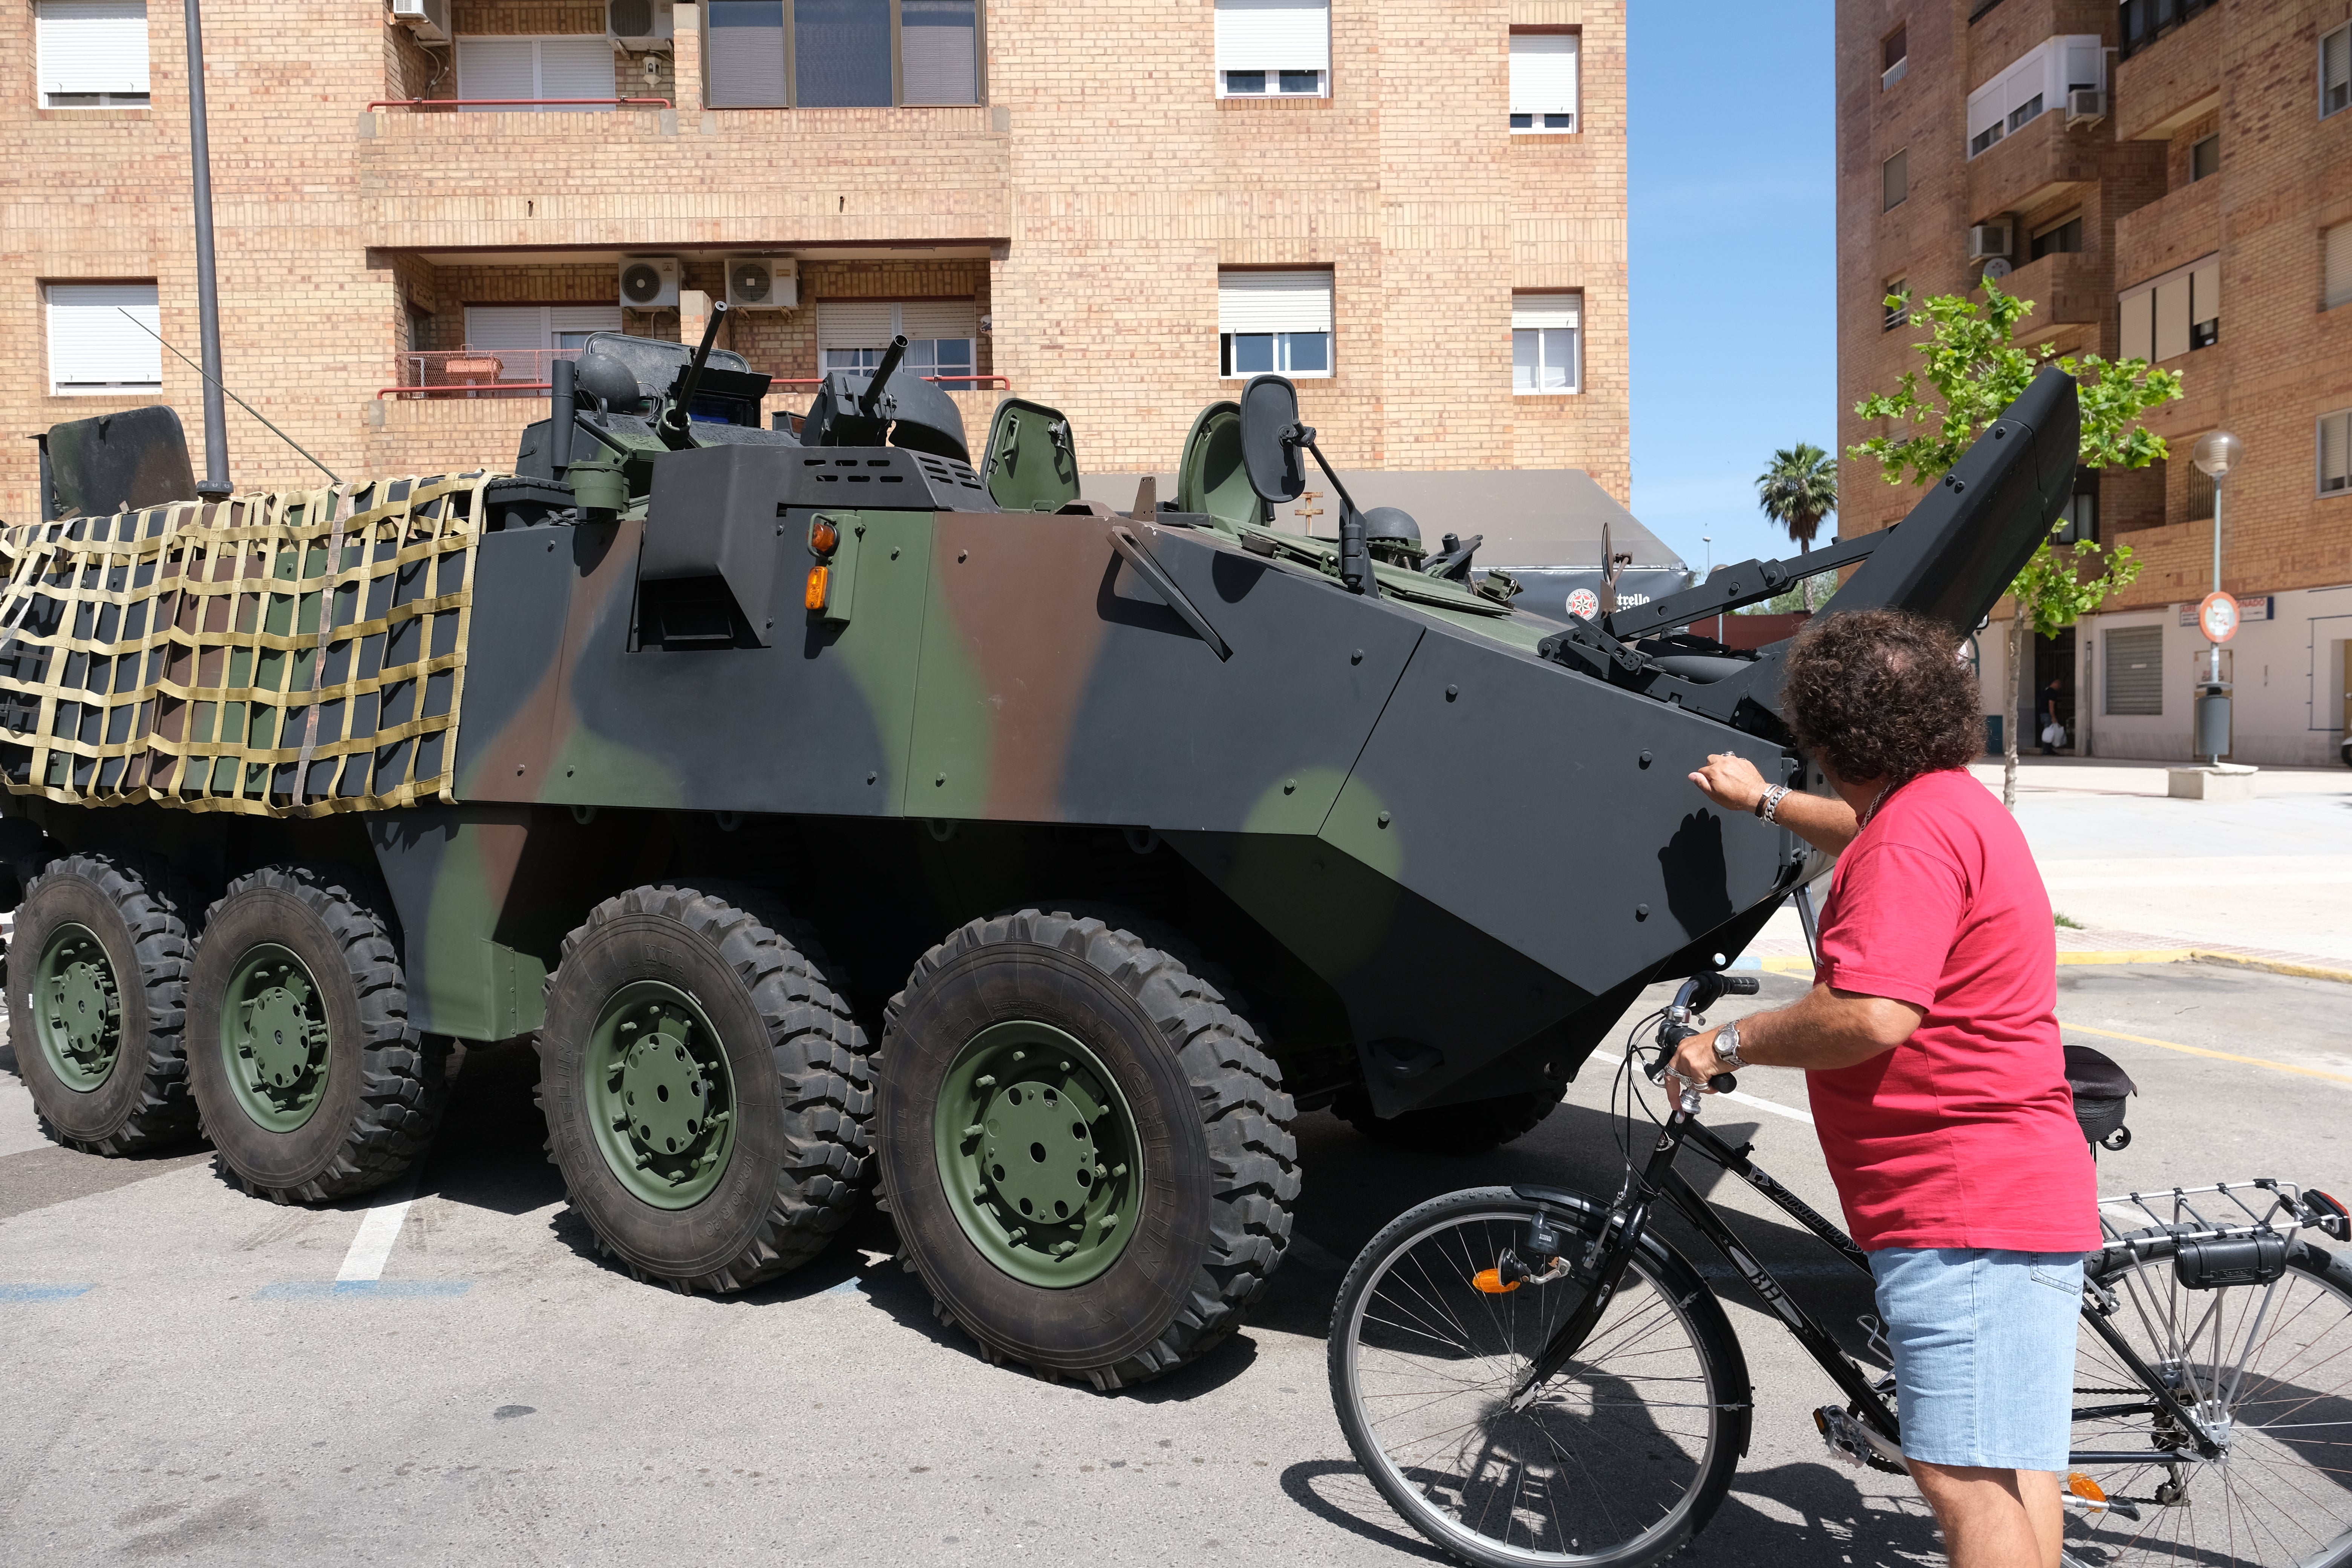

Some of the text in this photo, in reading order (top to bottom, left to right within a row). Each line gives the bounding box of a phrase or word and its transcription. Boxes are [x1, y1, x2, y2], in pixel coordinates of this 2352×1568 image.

[559, 1037, 614, 1215] MICHELIN
[1077, 1003, 1176, 1280] MICHELIN
[1746, 1269, 1784, 1303] BH
